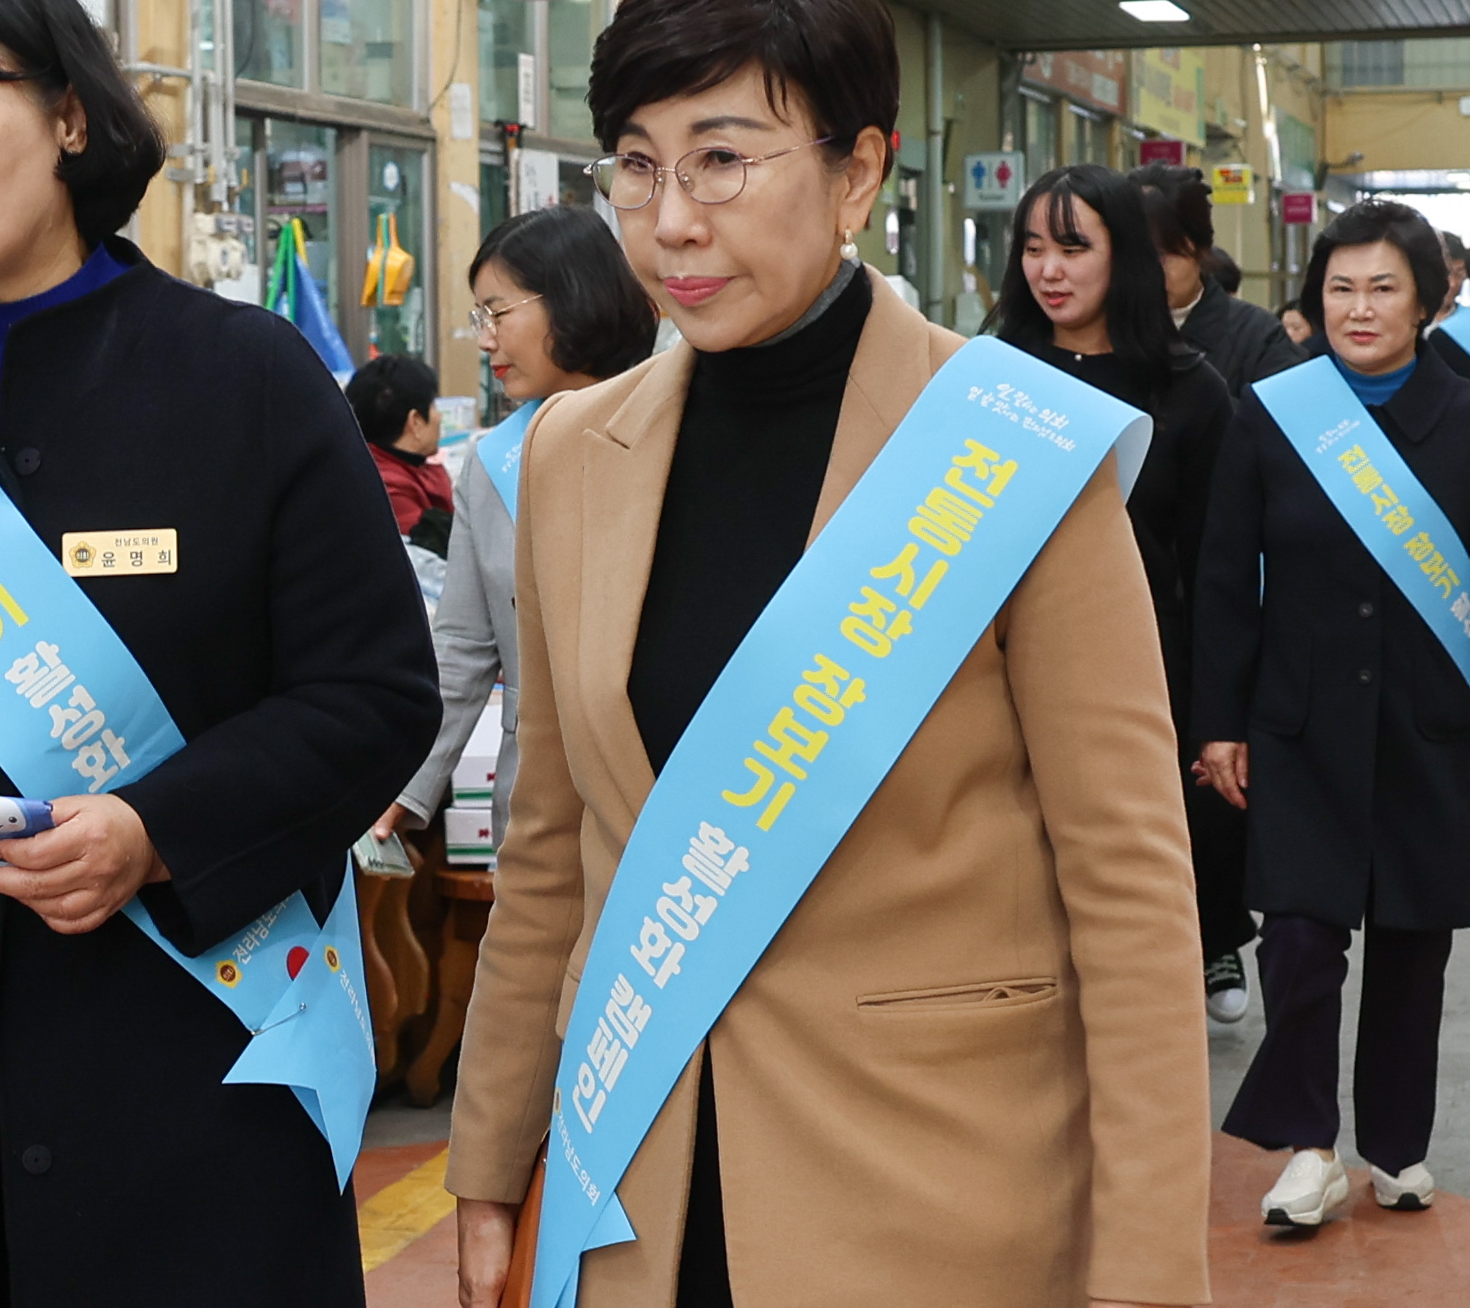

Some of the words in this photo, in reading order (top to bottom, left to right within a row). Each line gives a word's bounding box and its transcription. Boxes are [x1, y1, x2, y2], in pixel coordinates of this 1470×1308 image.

[1038, 408, 1070, 430] 의회
[114, 536, 160, 547] 전남도의원
[838, 437, 1019, 662] 전통시장
[4, 640, 133, 794] 활성화
[721, 651, 867, 833] 장보기
[629, 818, 753, 992] 활성화
[570, 975, 655, 1136] 캠페인
